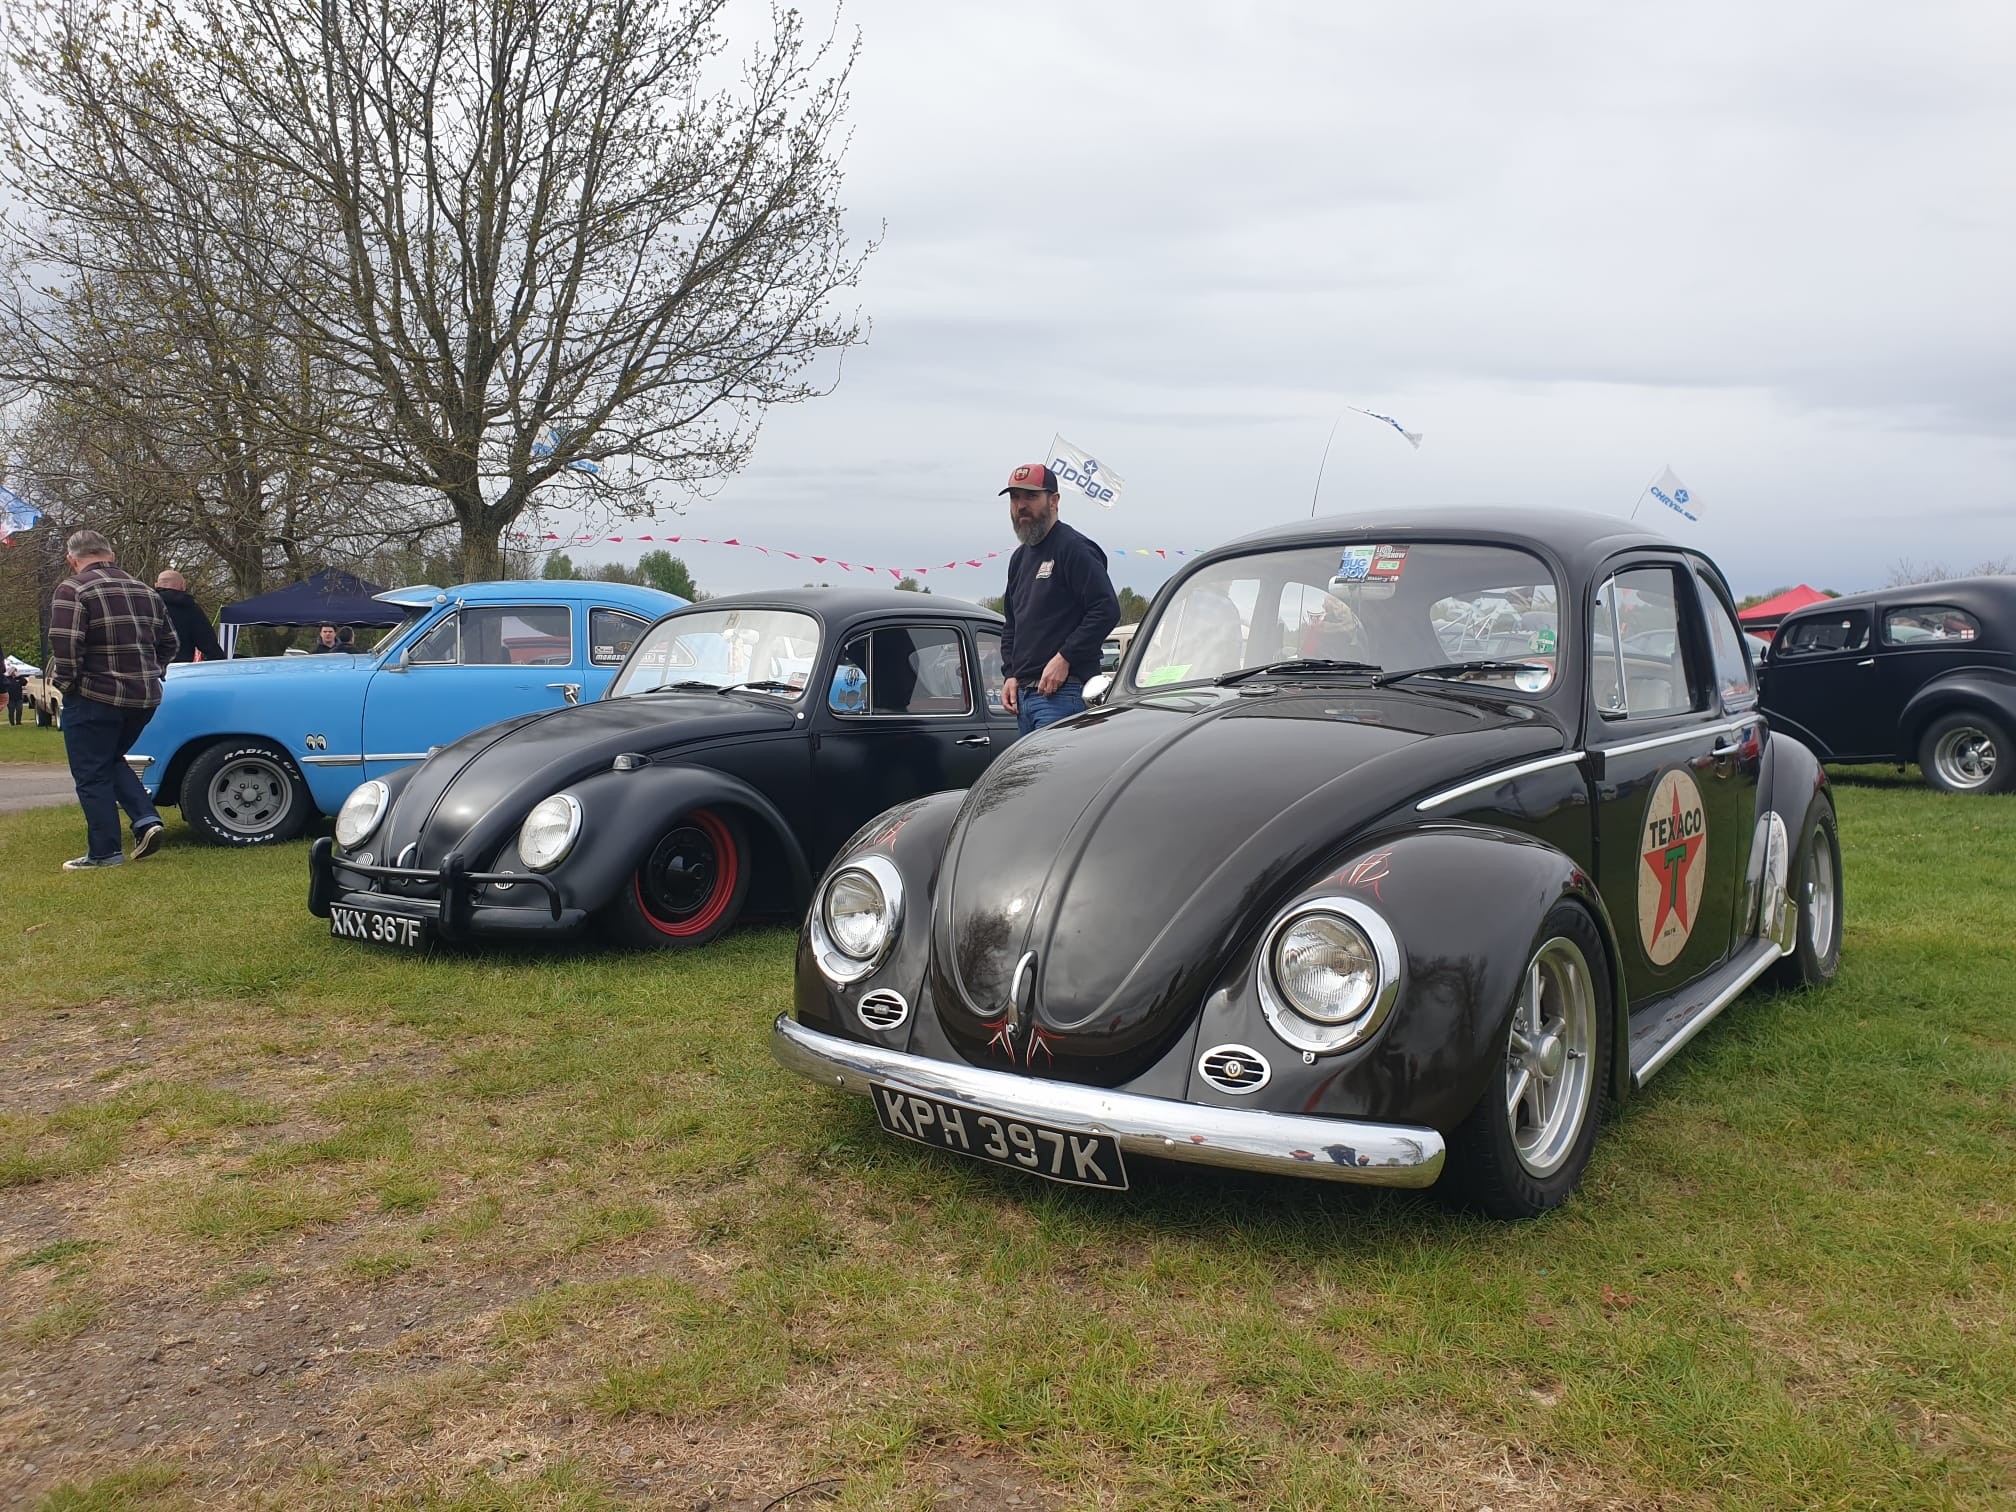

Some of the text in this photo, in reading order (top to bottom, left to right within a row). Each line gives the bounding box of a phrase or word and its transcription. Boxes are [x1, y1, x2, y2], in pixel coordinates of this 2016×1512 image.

[1050, 458, 1114, 503] Dodge
[1342, 559, 1368, 568] BUG
[224, 748, 280, 761] RADIAL
[211, 826, 274, 843] GALAXY
[1649, 807, 1702, 848] TEXACO
[1664, 843, 1687, 908] T
[331, 908, 420, 947] XKX 367F
[882, 1090, 1108, 1182] KPH 397K
